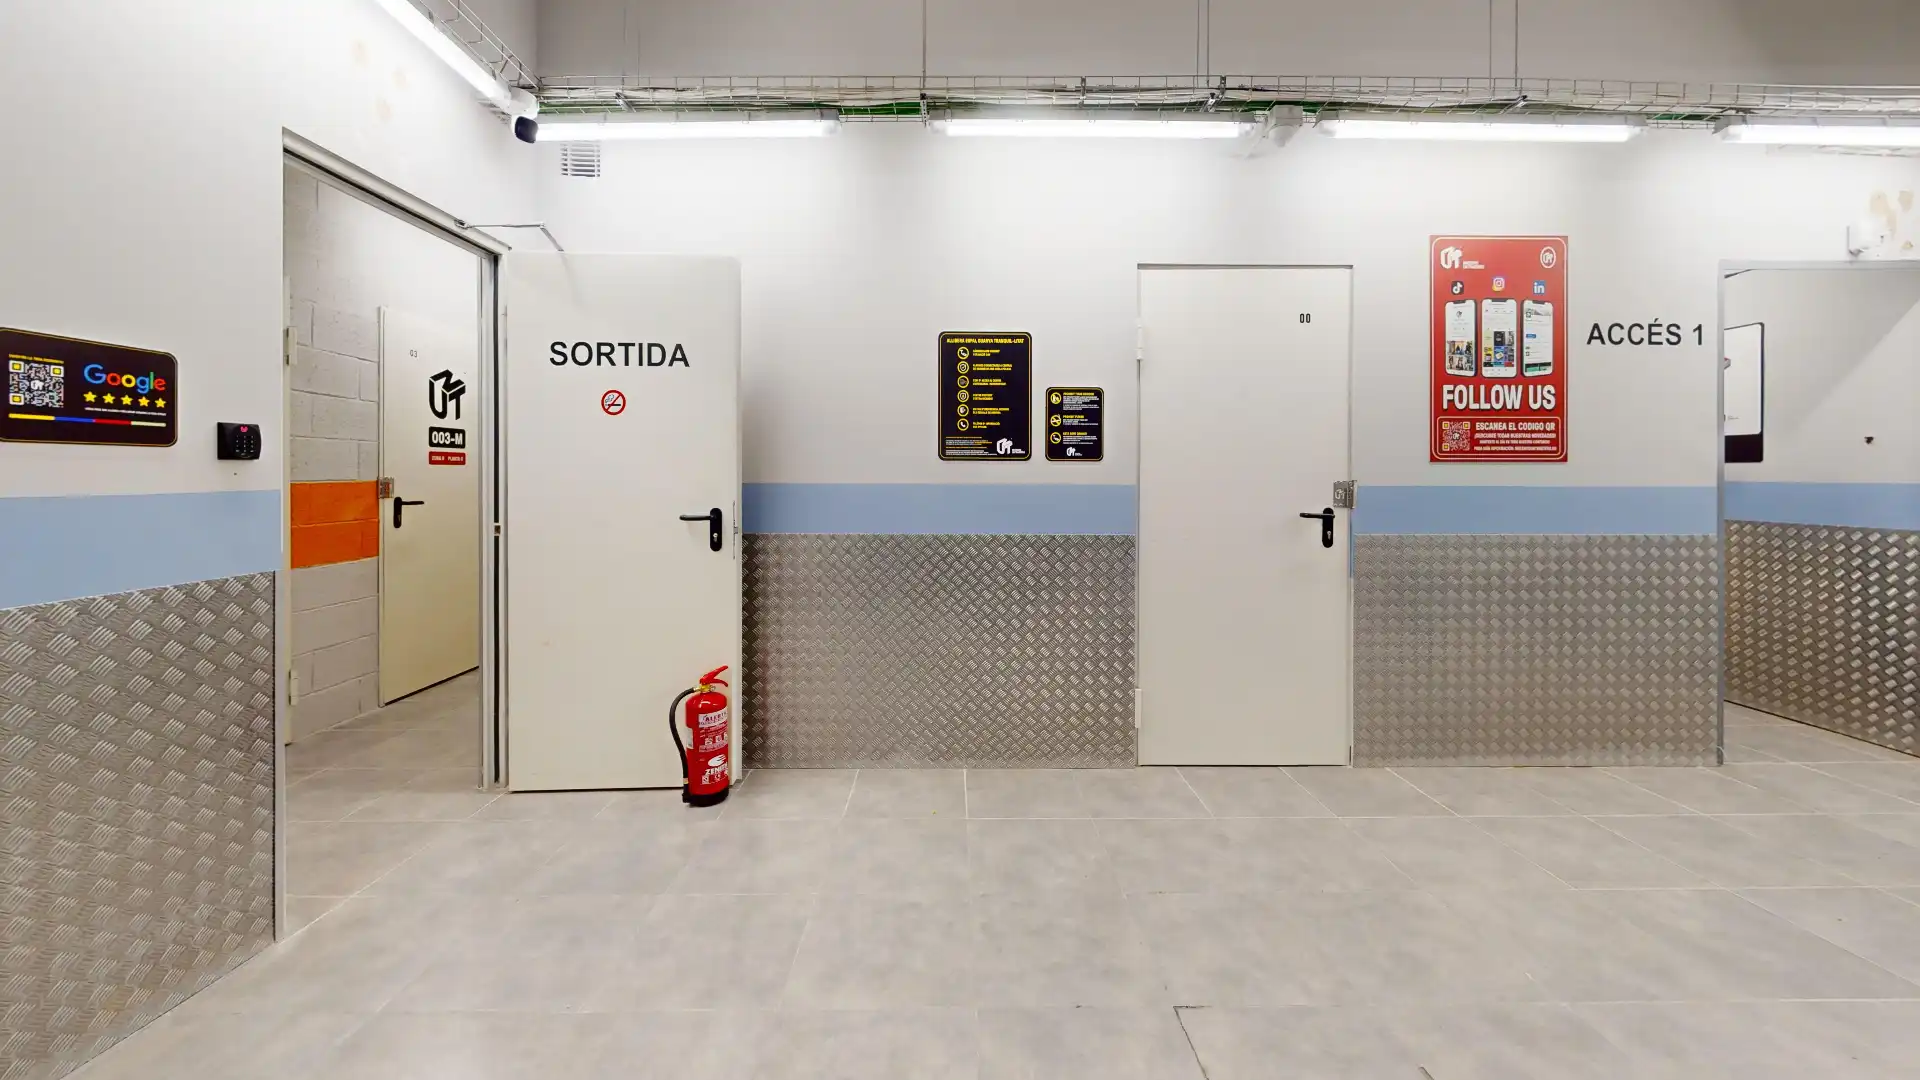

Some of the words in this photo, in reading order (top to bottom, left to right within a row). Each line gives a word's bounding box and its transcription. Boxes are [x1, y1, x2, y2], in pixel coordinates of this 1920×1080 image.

[1299, 313, 1311, 323] 00
[1586, 317, 1682, 346] ACCÉS
[1692, 323, 1703, 346] 1
[549, 341, 690, 367] SORTIDA
[84, 363, 167, 394] Google
[1442, 384, 1523, 410] FOLLOW
[1528, 384, 1556, 410] US
[431, 431, 463, 445] 003-M
[1475, 422, 1507, 431] ESCANEA
[1508, 422, 1517, 431] EL
[1518, 422, 1544, 431] CODIGO
[1545, 422, 1556, 431] QR
